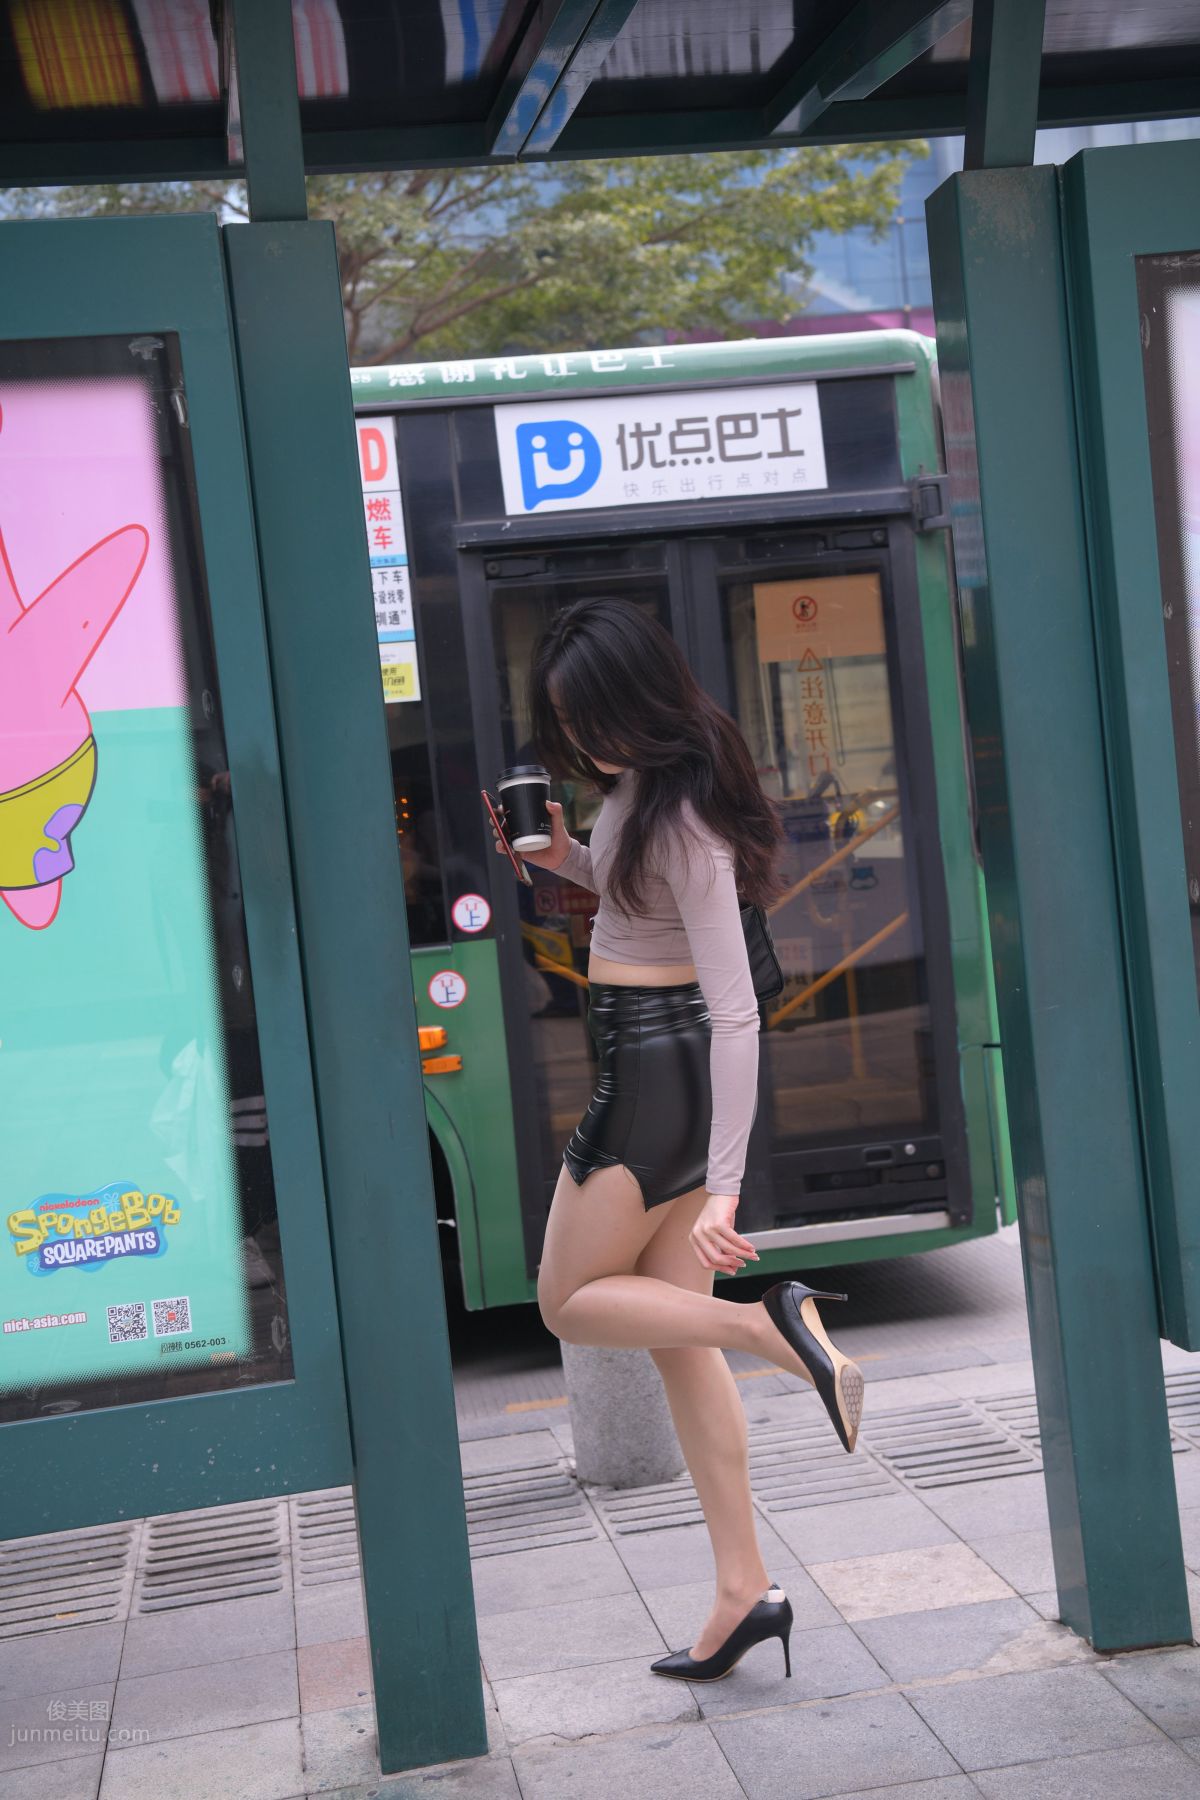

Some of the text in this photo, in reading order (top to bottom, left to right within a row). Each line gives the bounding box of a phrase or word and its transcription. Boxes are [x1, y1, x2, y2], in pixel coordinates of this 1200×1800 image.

[388, 350, 675, 386] 感谢礼让巴士
[615, 407, 805, 471] 优点巴士
[622, 467, 808, 498] 快乐出行点对点
[39, 1197, 100, 1211] nickelodeon
[43, 1231, 157, 1265] SQUAREPANTS
[3, 1312, 87, 1334] nick-asia.com
[184, 1337, 227, 1350] 0562-003
